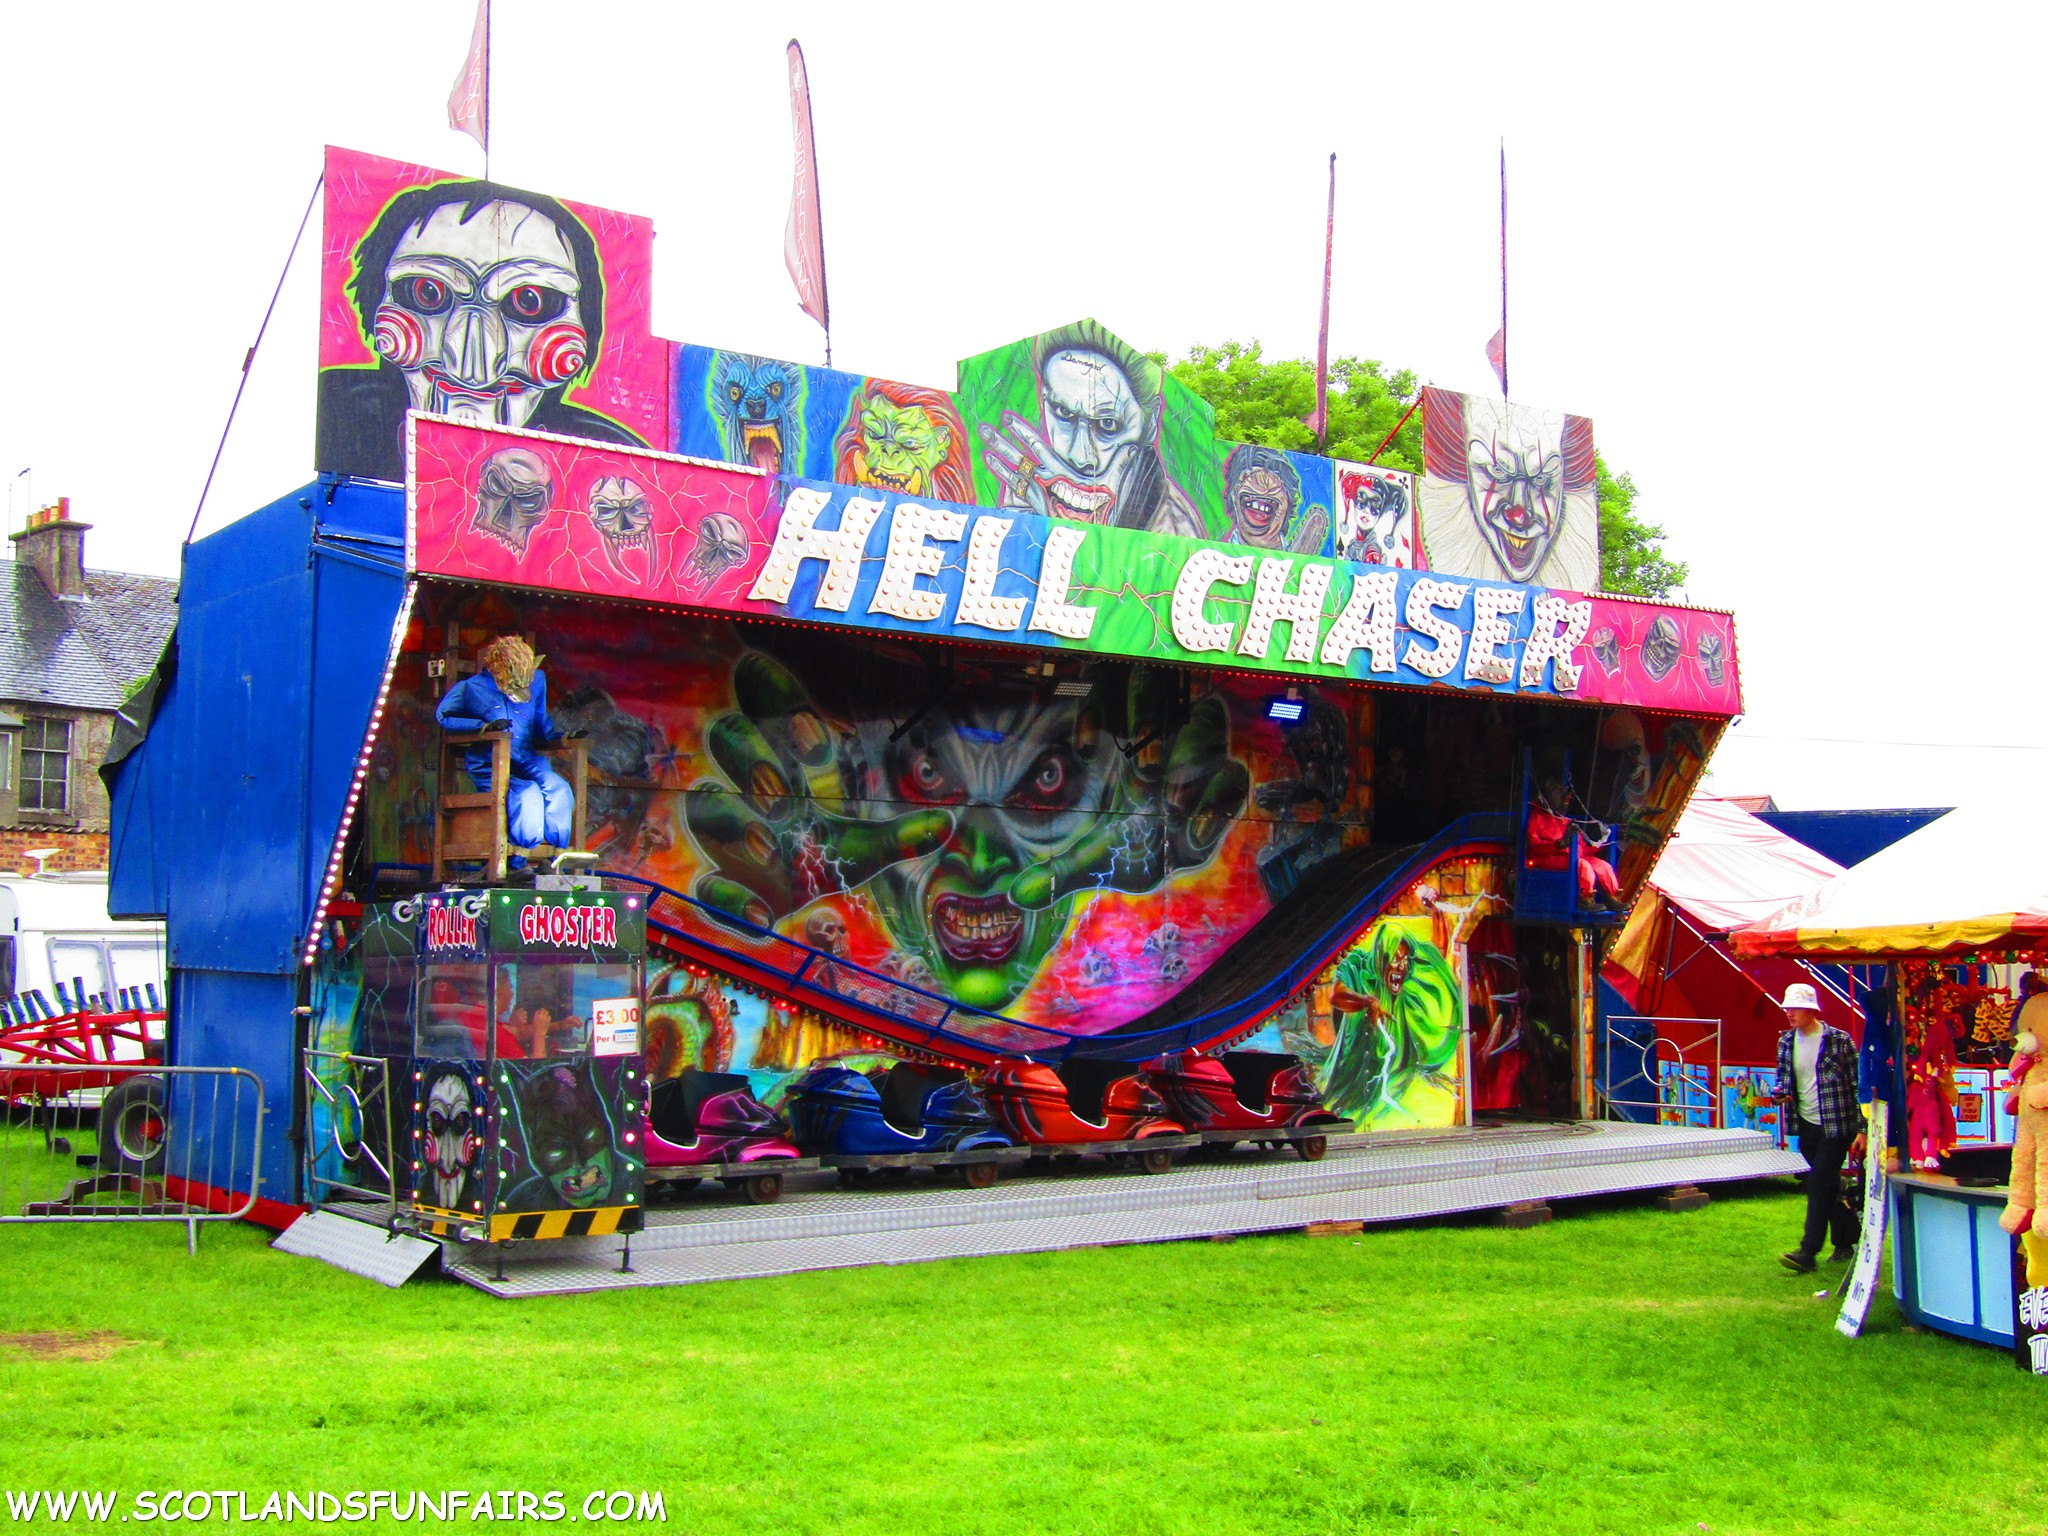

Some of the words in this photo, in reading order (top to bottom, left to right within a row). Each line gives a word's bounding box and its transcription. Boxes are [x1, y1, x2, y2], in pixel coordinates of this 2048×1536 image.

[747, 487, 1097, 639] HELL
[1171, 549, 1593, 691] CHASER
[428, 906, 477, 951] ROLLER
[520, 904, 617, 950] GHOSTER
[596, 1007, 640, 1025] £3.00
[596, 1034, 610, 1043] Per
[1852, 1279, 1865, 1304] Win
